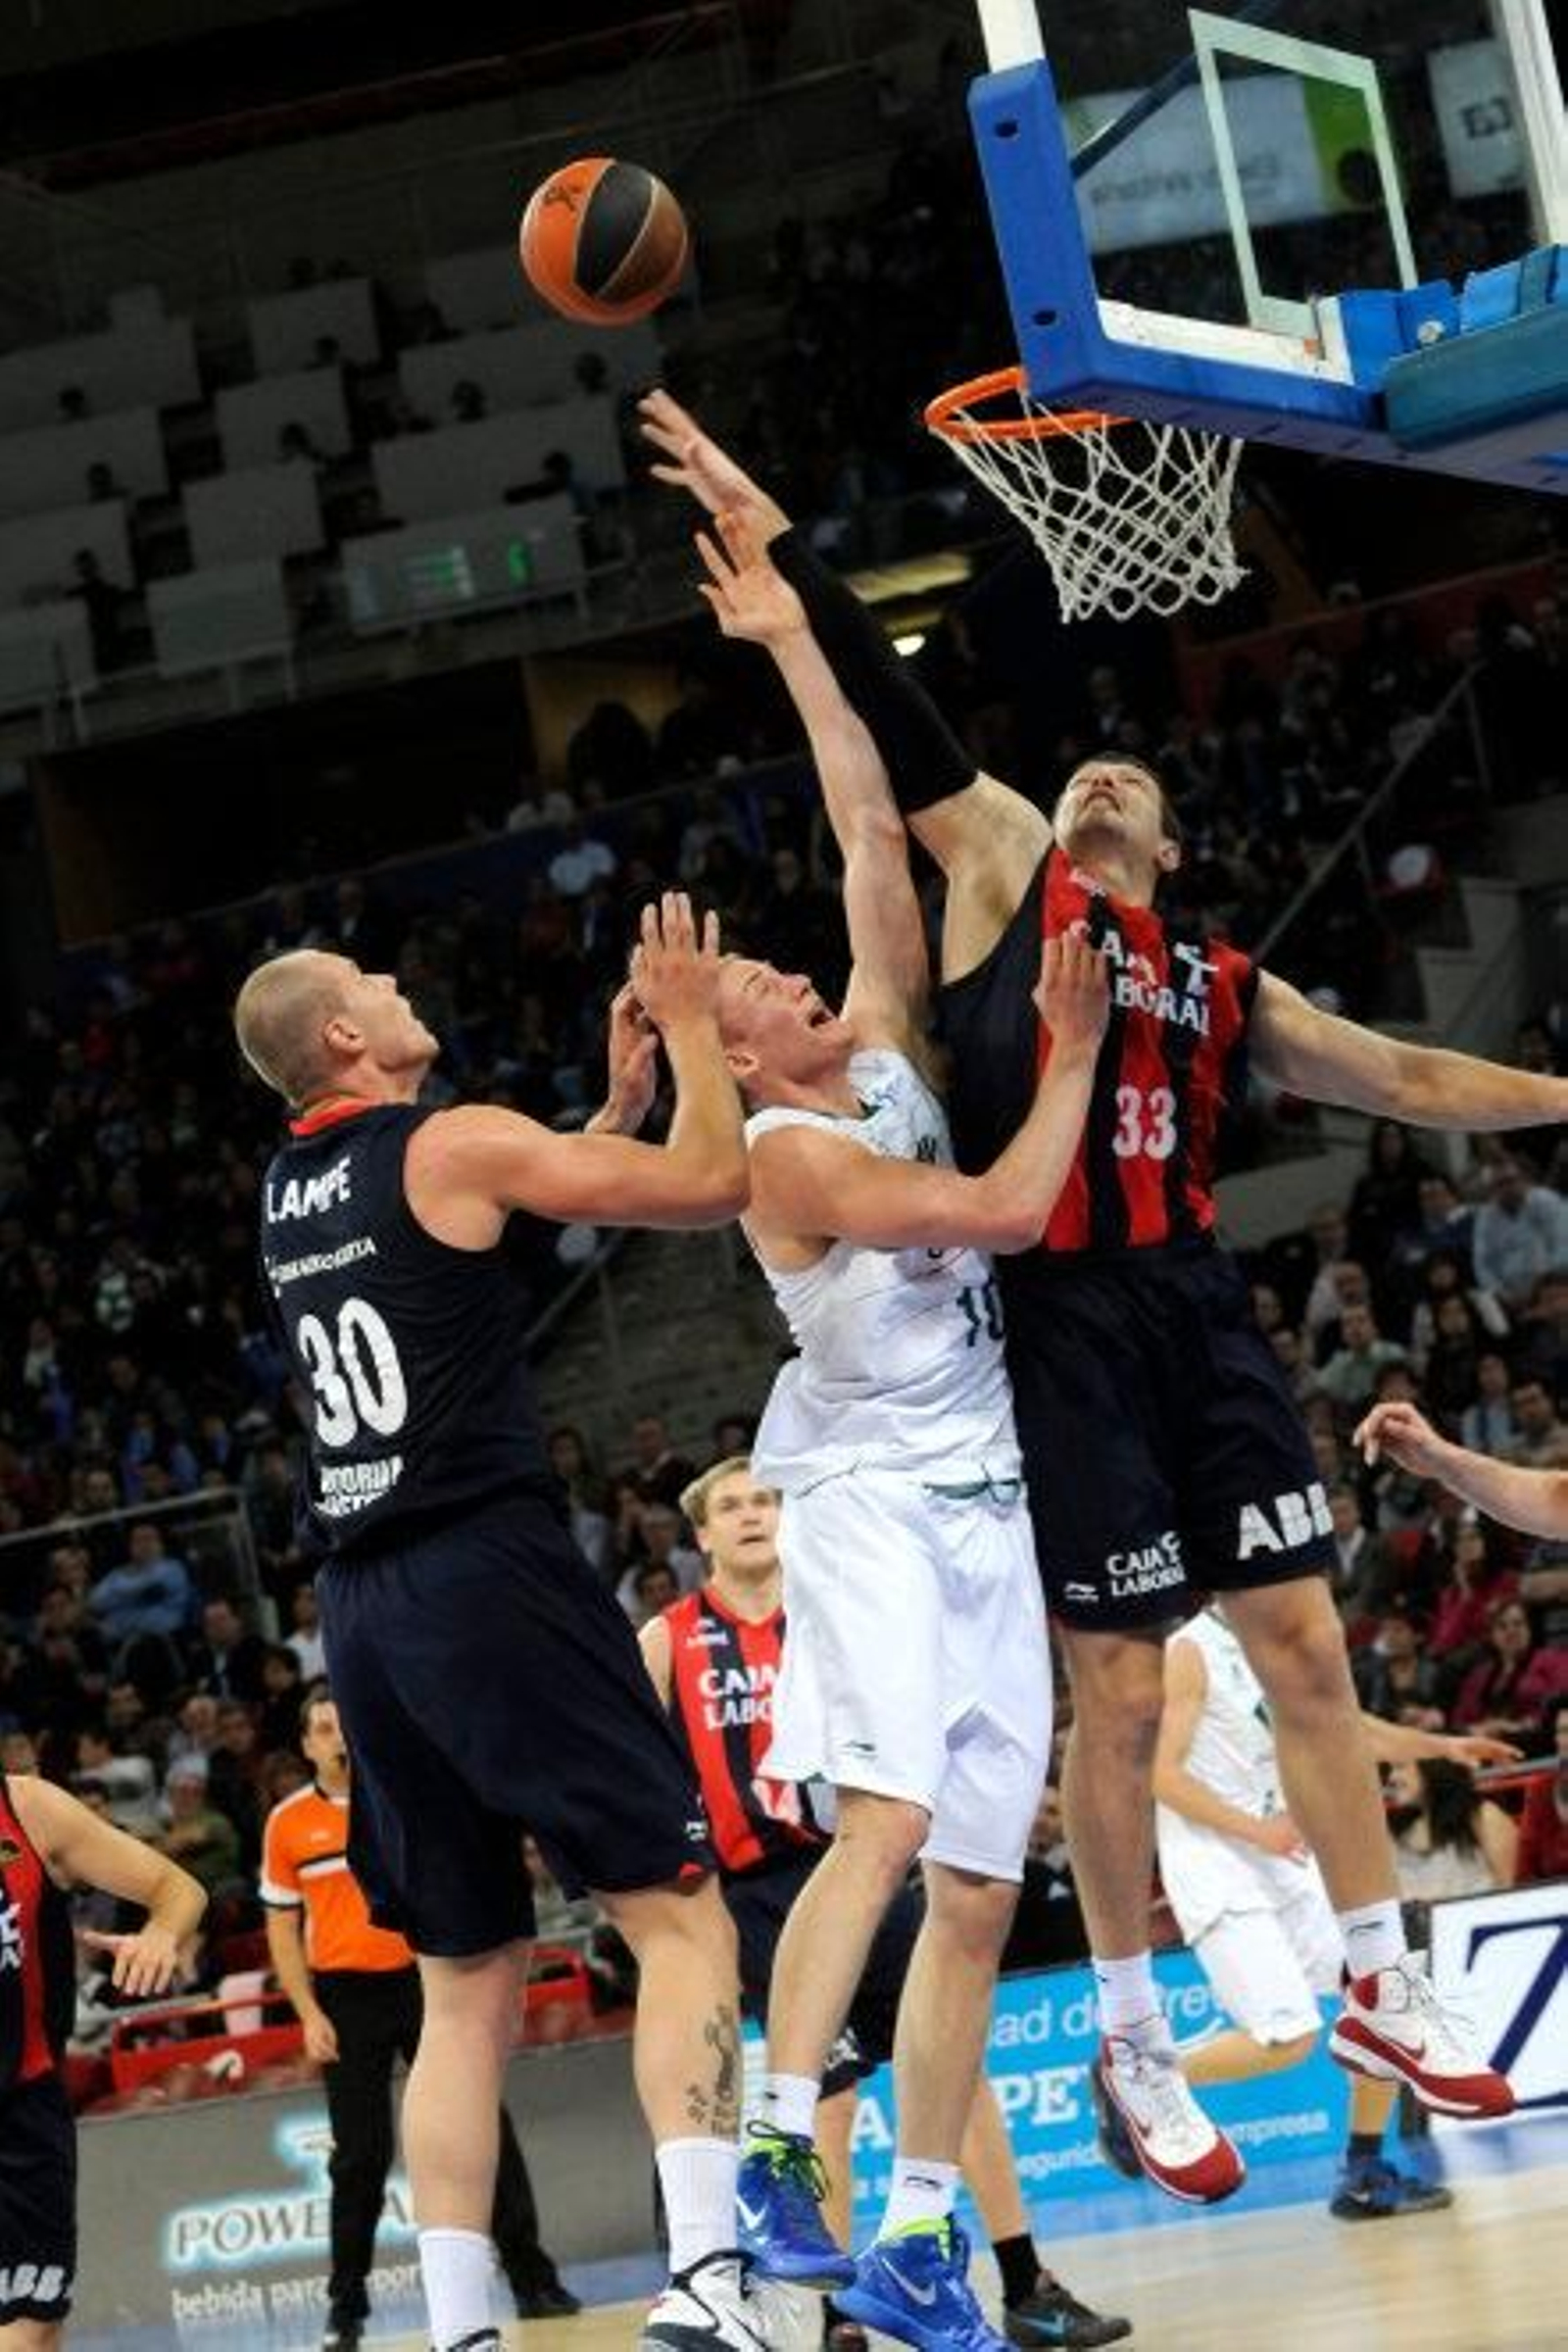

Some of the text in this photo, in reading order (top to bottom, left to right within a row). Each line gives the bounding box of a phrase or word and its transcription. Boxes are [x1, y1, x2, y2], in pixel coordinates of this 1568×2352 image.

[1112, 1084, 1176, 1159] 33
[267, 1154, 351, 1223] LAMPE
[298, 1297, 408, 1447] 30
